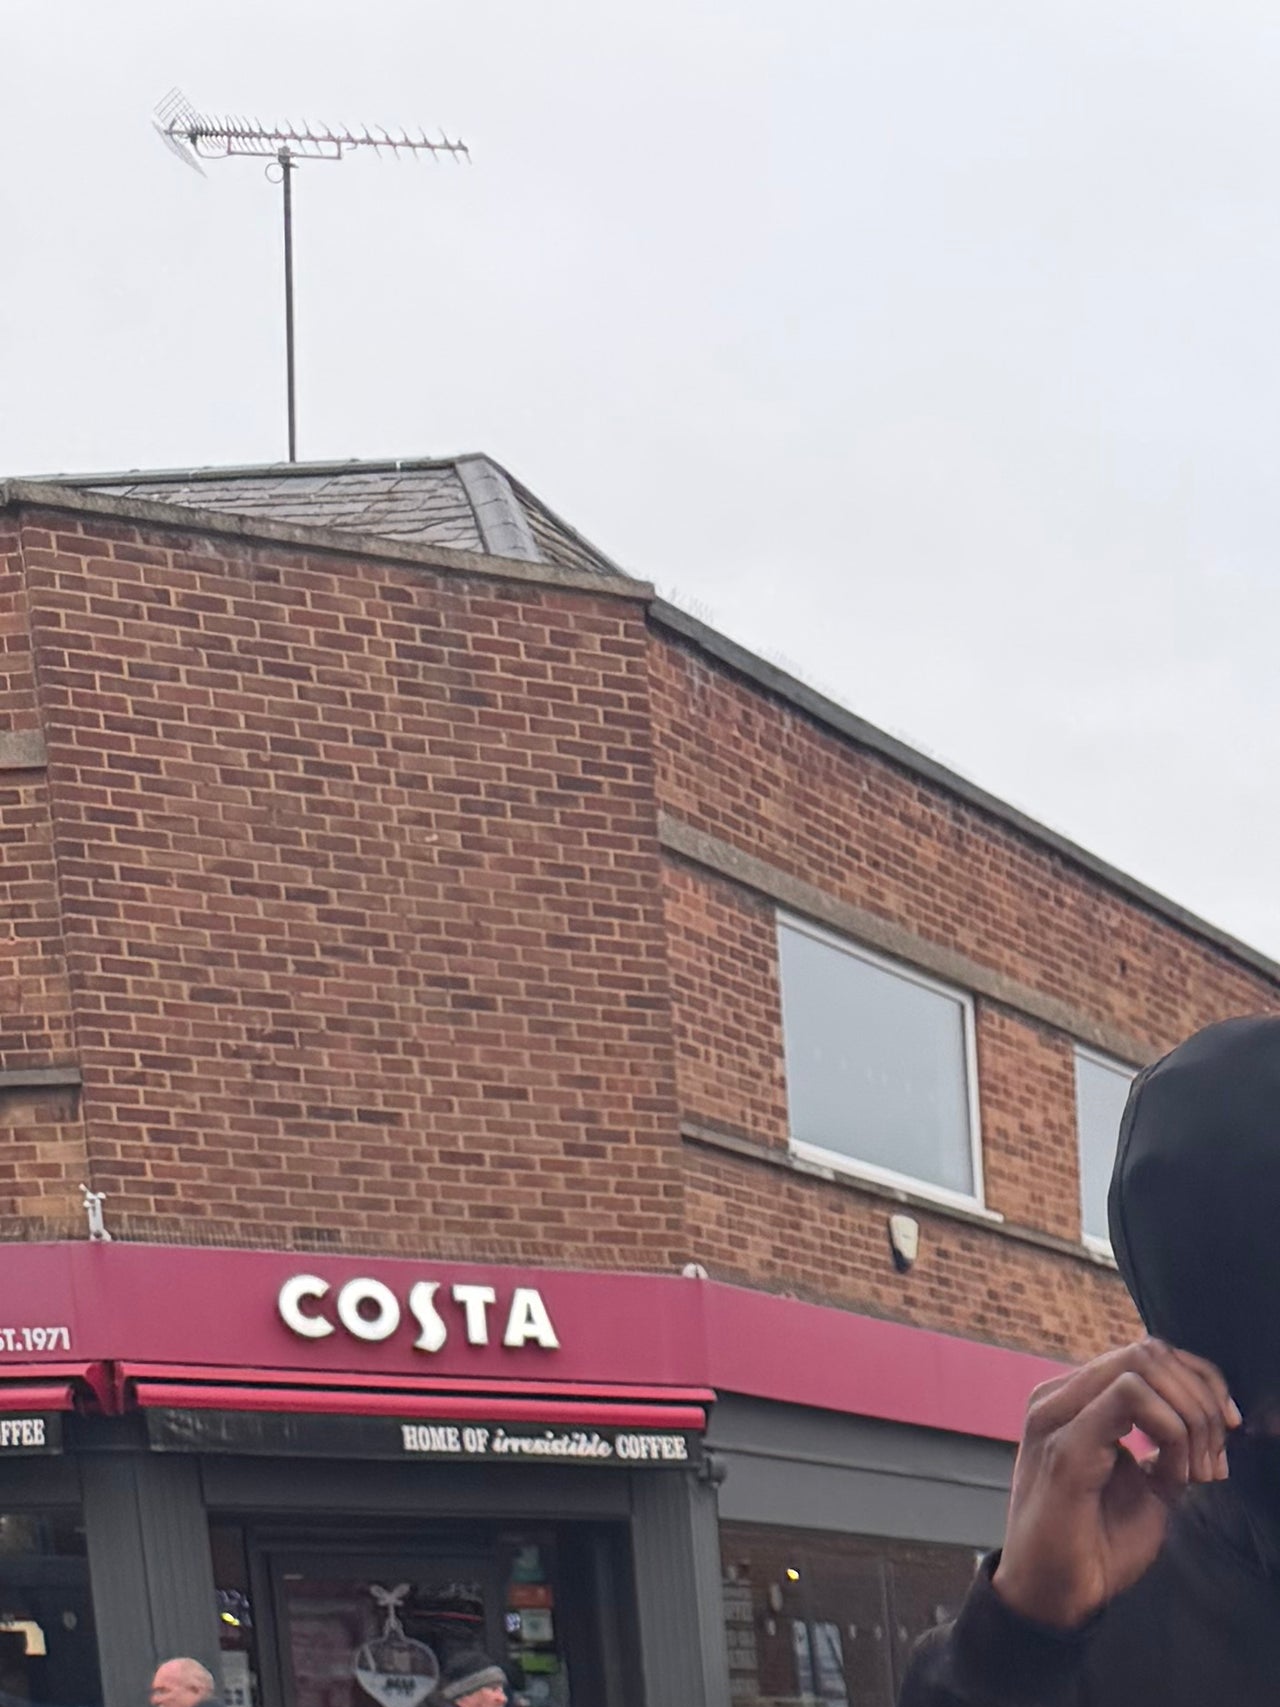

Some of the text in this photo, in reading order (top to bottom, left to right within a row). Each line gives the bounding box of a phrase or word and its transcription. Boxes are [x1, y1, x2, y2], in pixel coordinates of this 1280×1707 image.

[278, 1274, 560, 1353] COSTA
[0, 1419, 45, 1445] FFEE
[401, 1424, 688, 1460] HOME OF irresistible COFFEE
